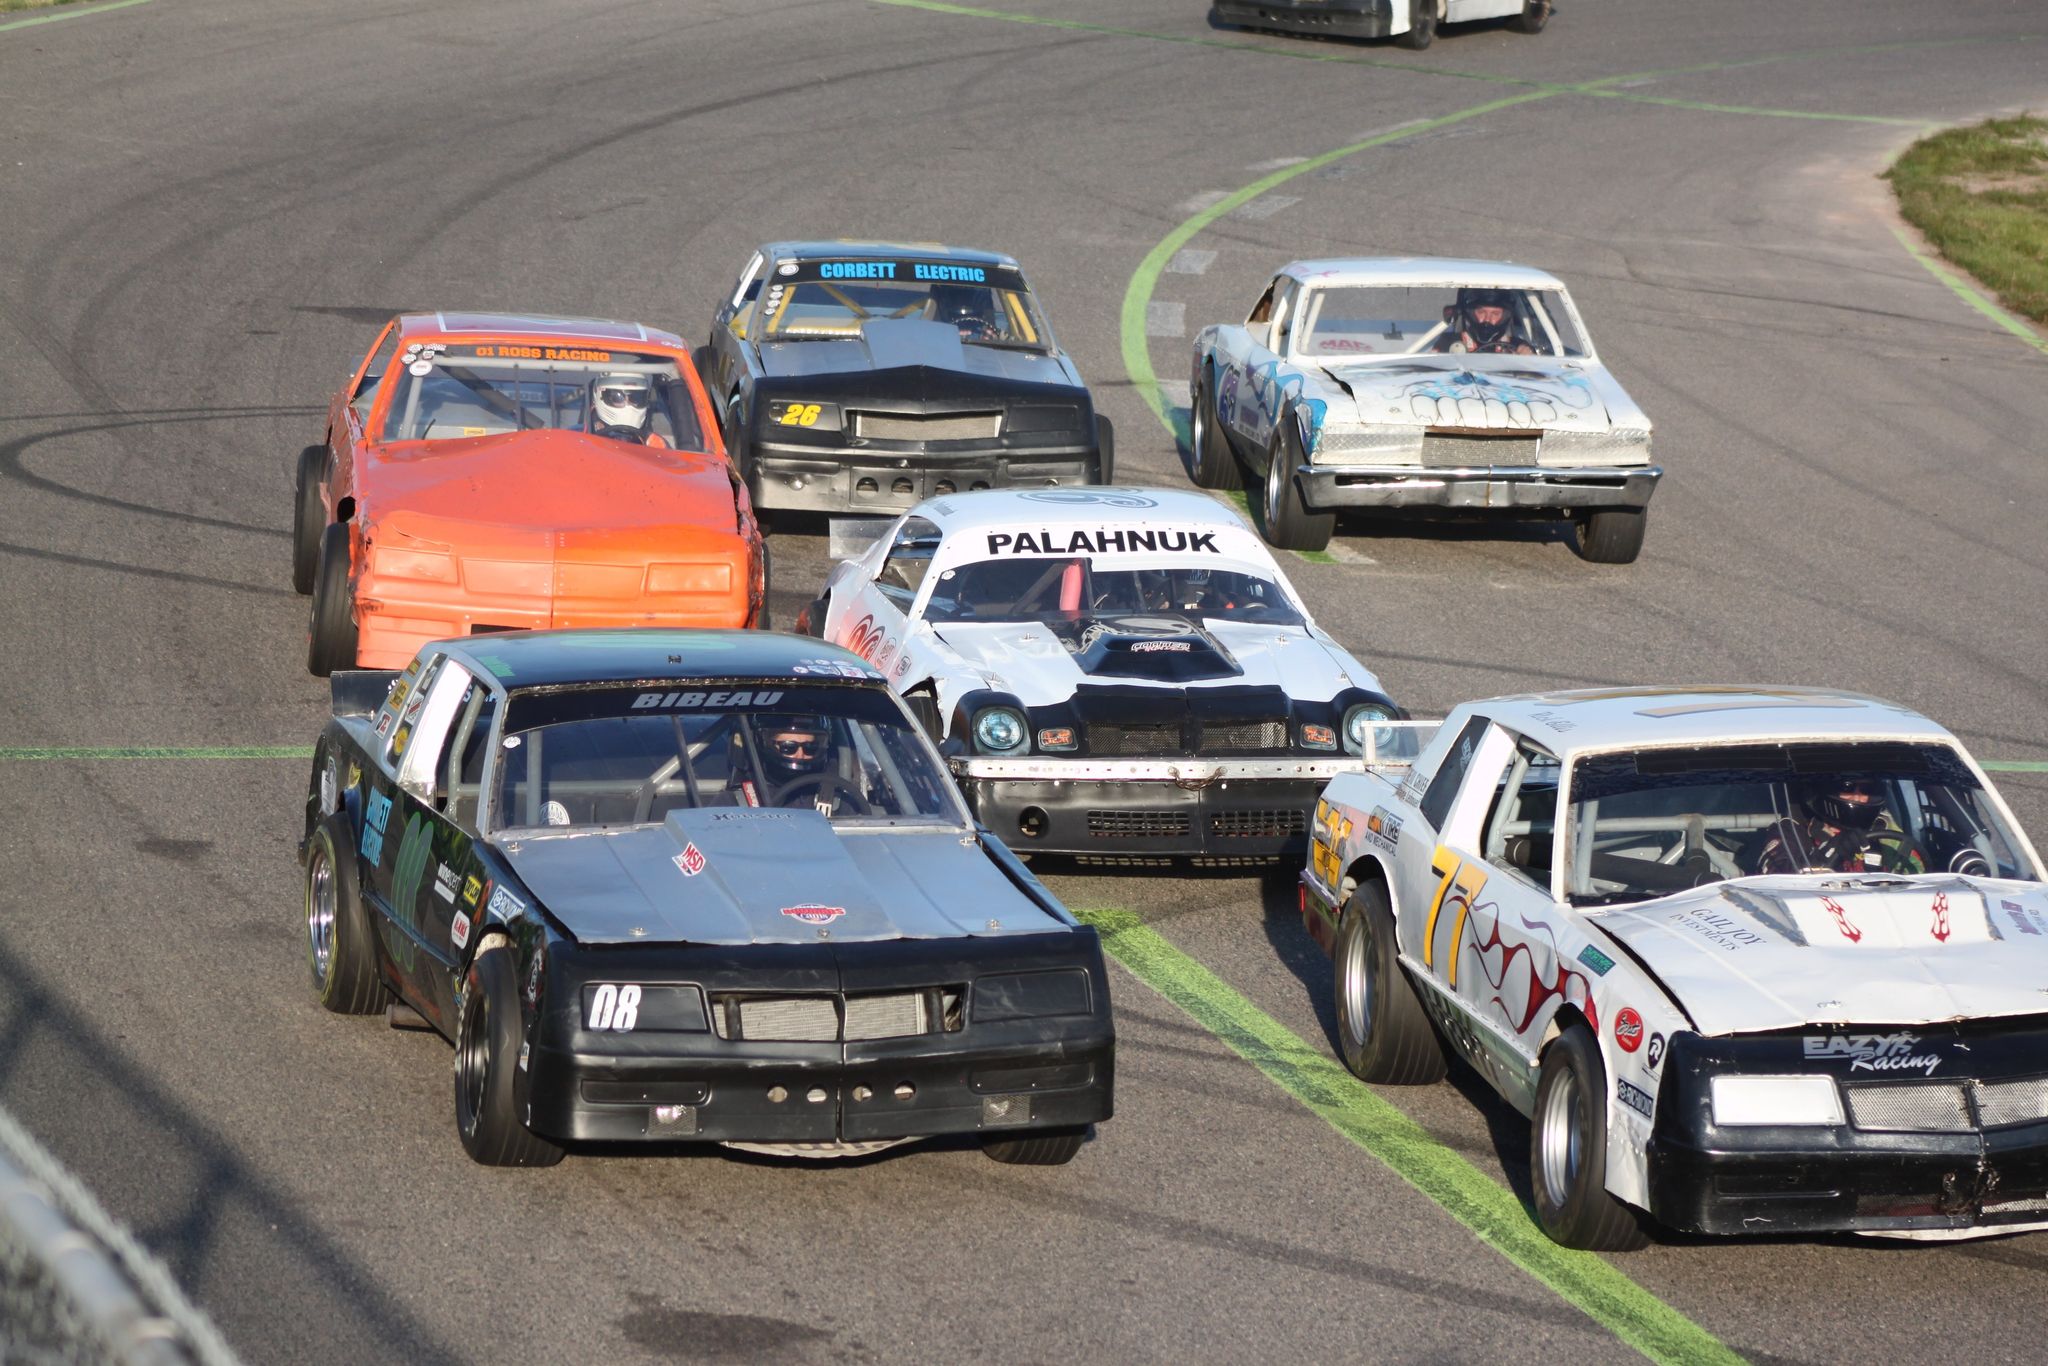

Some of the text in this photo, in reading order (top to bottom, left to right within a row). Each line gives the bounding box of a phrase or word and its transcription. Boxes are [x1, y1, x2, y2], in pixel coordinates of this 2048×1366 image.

[820, 262, 985, 282] CORBETT ELECTRIC
[498, 346, 541, 359] ROSS
[545, 348, 610, 362] RACING
[780, 404, 821, 426] 26
[987, 530, 1221, 555] PALAHNUK
[630, 691, 785, 709] BIBEAU
[682, 843, 705, 873] MSD
[1424, 846, 1488, 991] 77
[1690, 908, 1767, 945] GAIL JOY
[1669, 913, 1740, 951] INVESTMENTS
[589, 984, 642, 1033] 08
[1850, 1052, 1942, 1076] Racing
